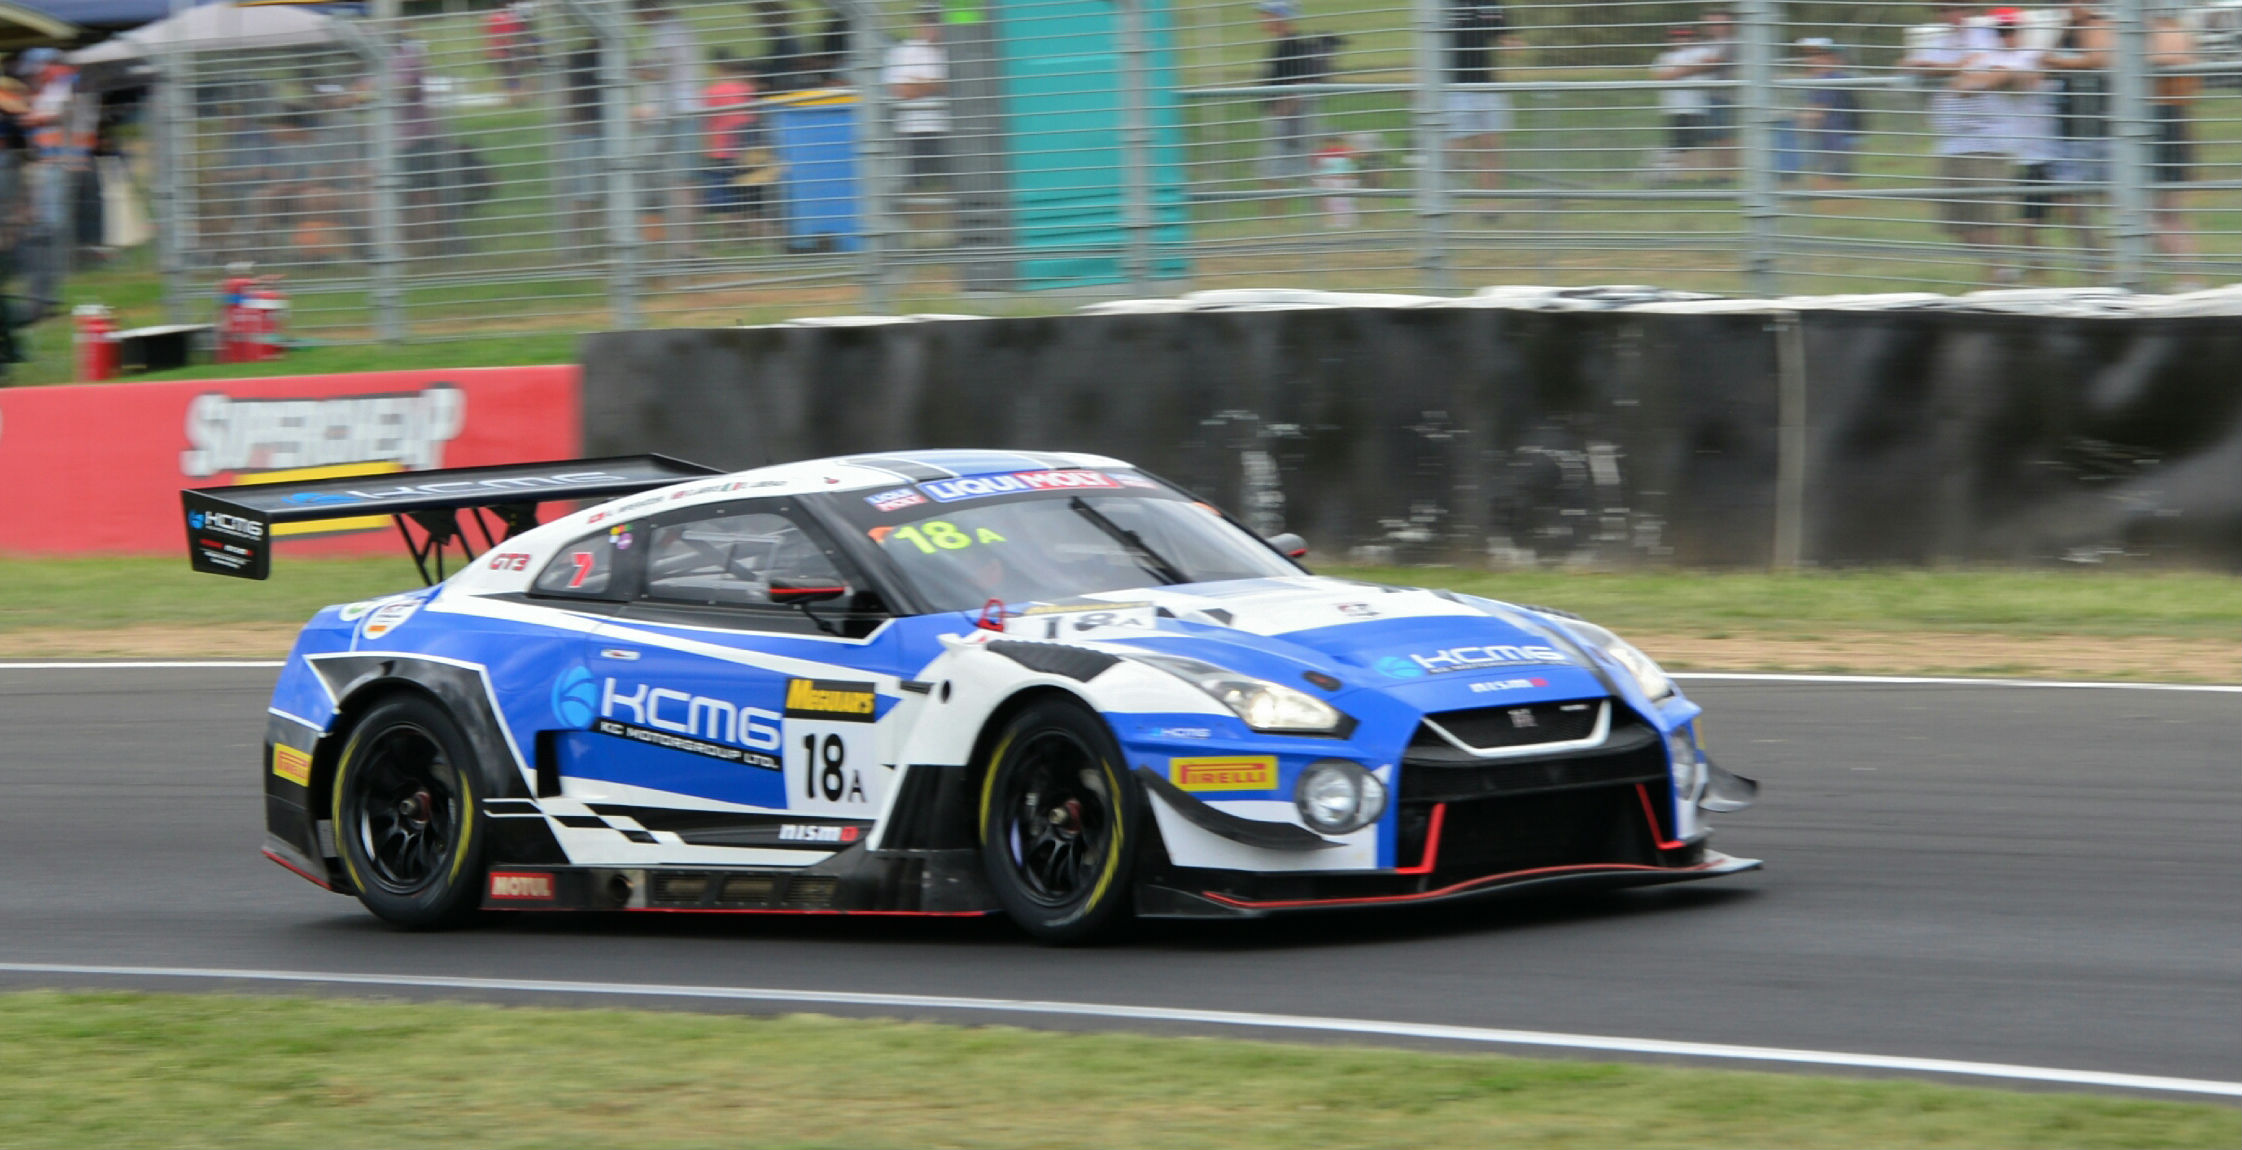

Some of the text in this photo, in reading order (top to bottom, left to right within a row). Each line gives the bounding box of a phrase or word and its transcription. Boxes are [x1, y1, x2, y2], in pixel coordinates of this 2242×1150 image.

[925, 474, 1030, 498] LIQUI
[1014, 471, 1111, 487] MOLY
[489, 553, 531, 571] GT3
[600, 721, 624, 736] KC
[626, 727, 742, 760] MOTORGROUP
[1180, 763, 1267, 785] PIRELLI
[491, 876, 552, 897] MOTUL
